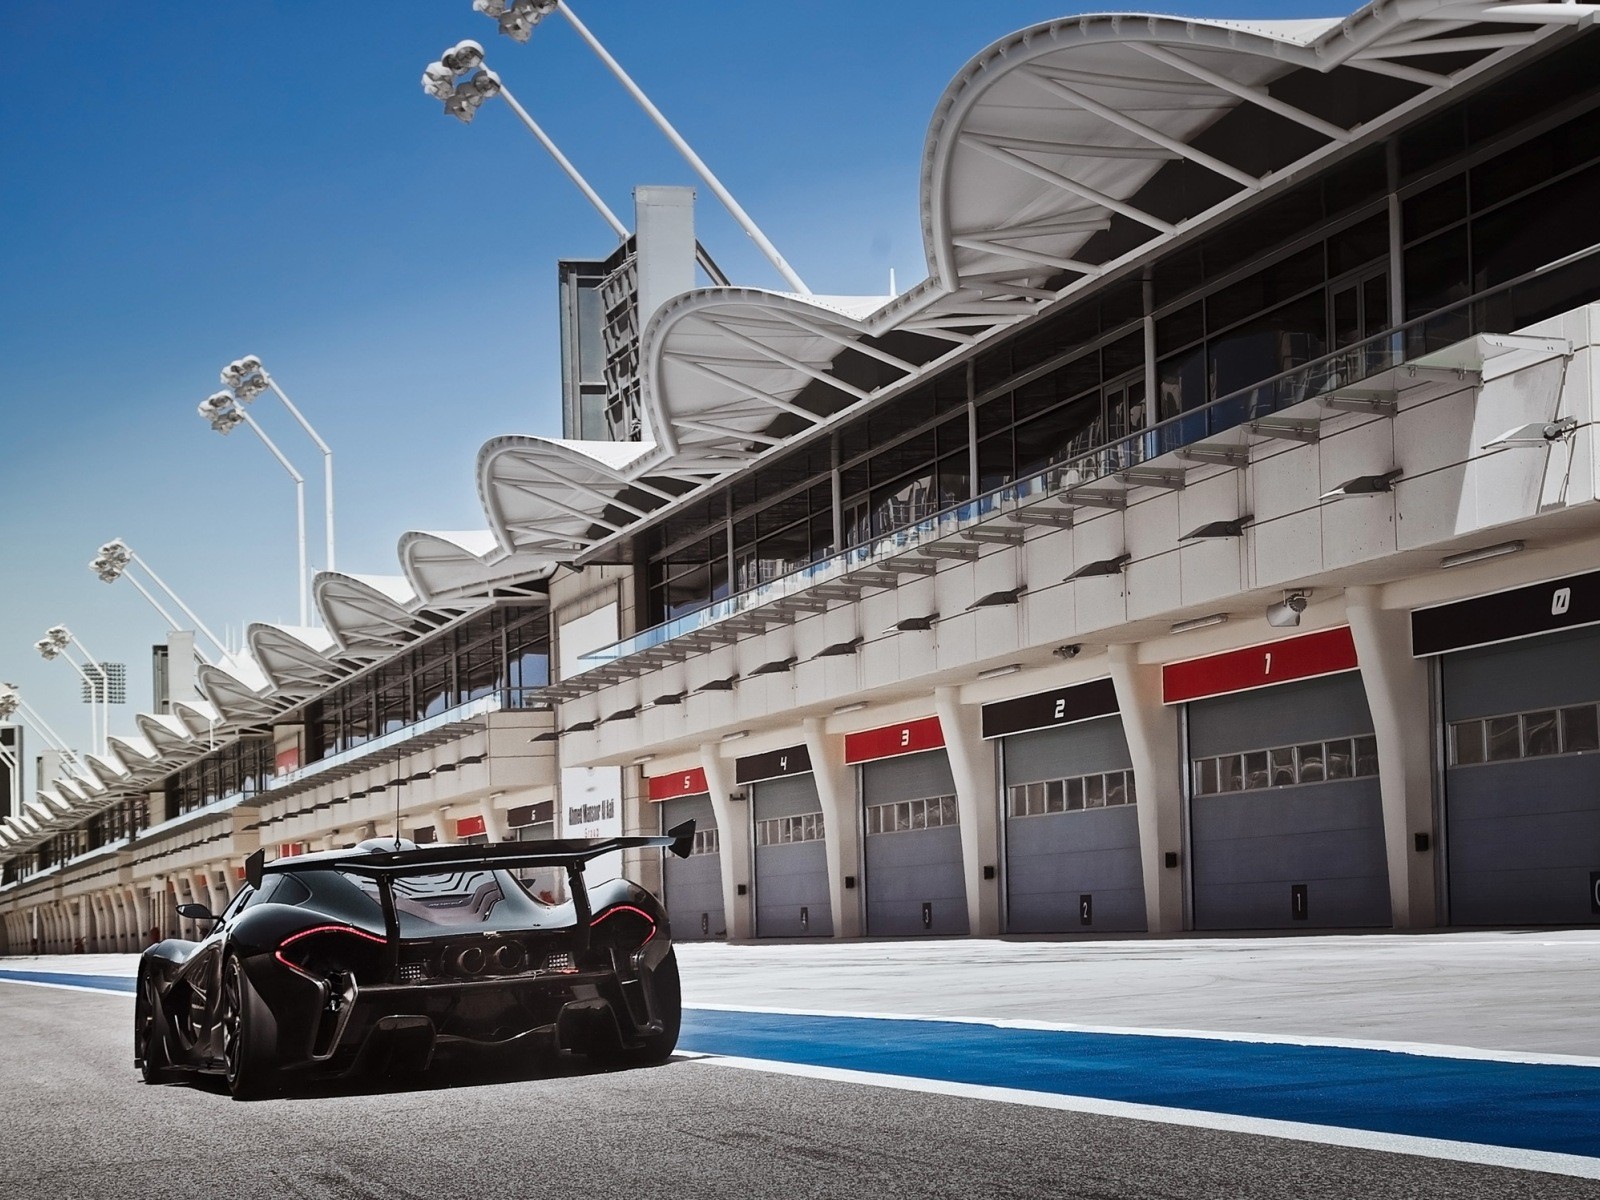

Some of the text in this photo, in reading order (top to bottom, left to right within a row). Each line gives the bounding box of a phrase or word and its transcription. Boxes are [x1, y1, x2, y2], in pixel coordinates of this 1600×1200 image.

[1551, 587, 1571, 616] 0
[1263, 652, 1272, 675] 1
[1054, 698, 1066, 719] 2
[900, 729, 910, 746] 3
[779, 756, 787, 771] 4
[683, 775, 691, 789] 5
[1082, 902, 1088, 918] 2
[1296, 893, 1301, 912] 1
[924, 908, 930, 923] 3
